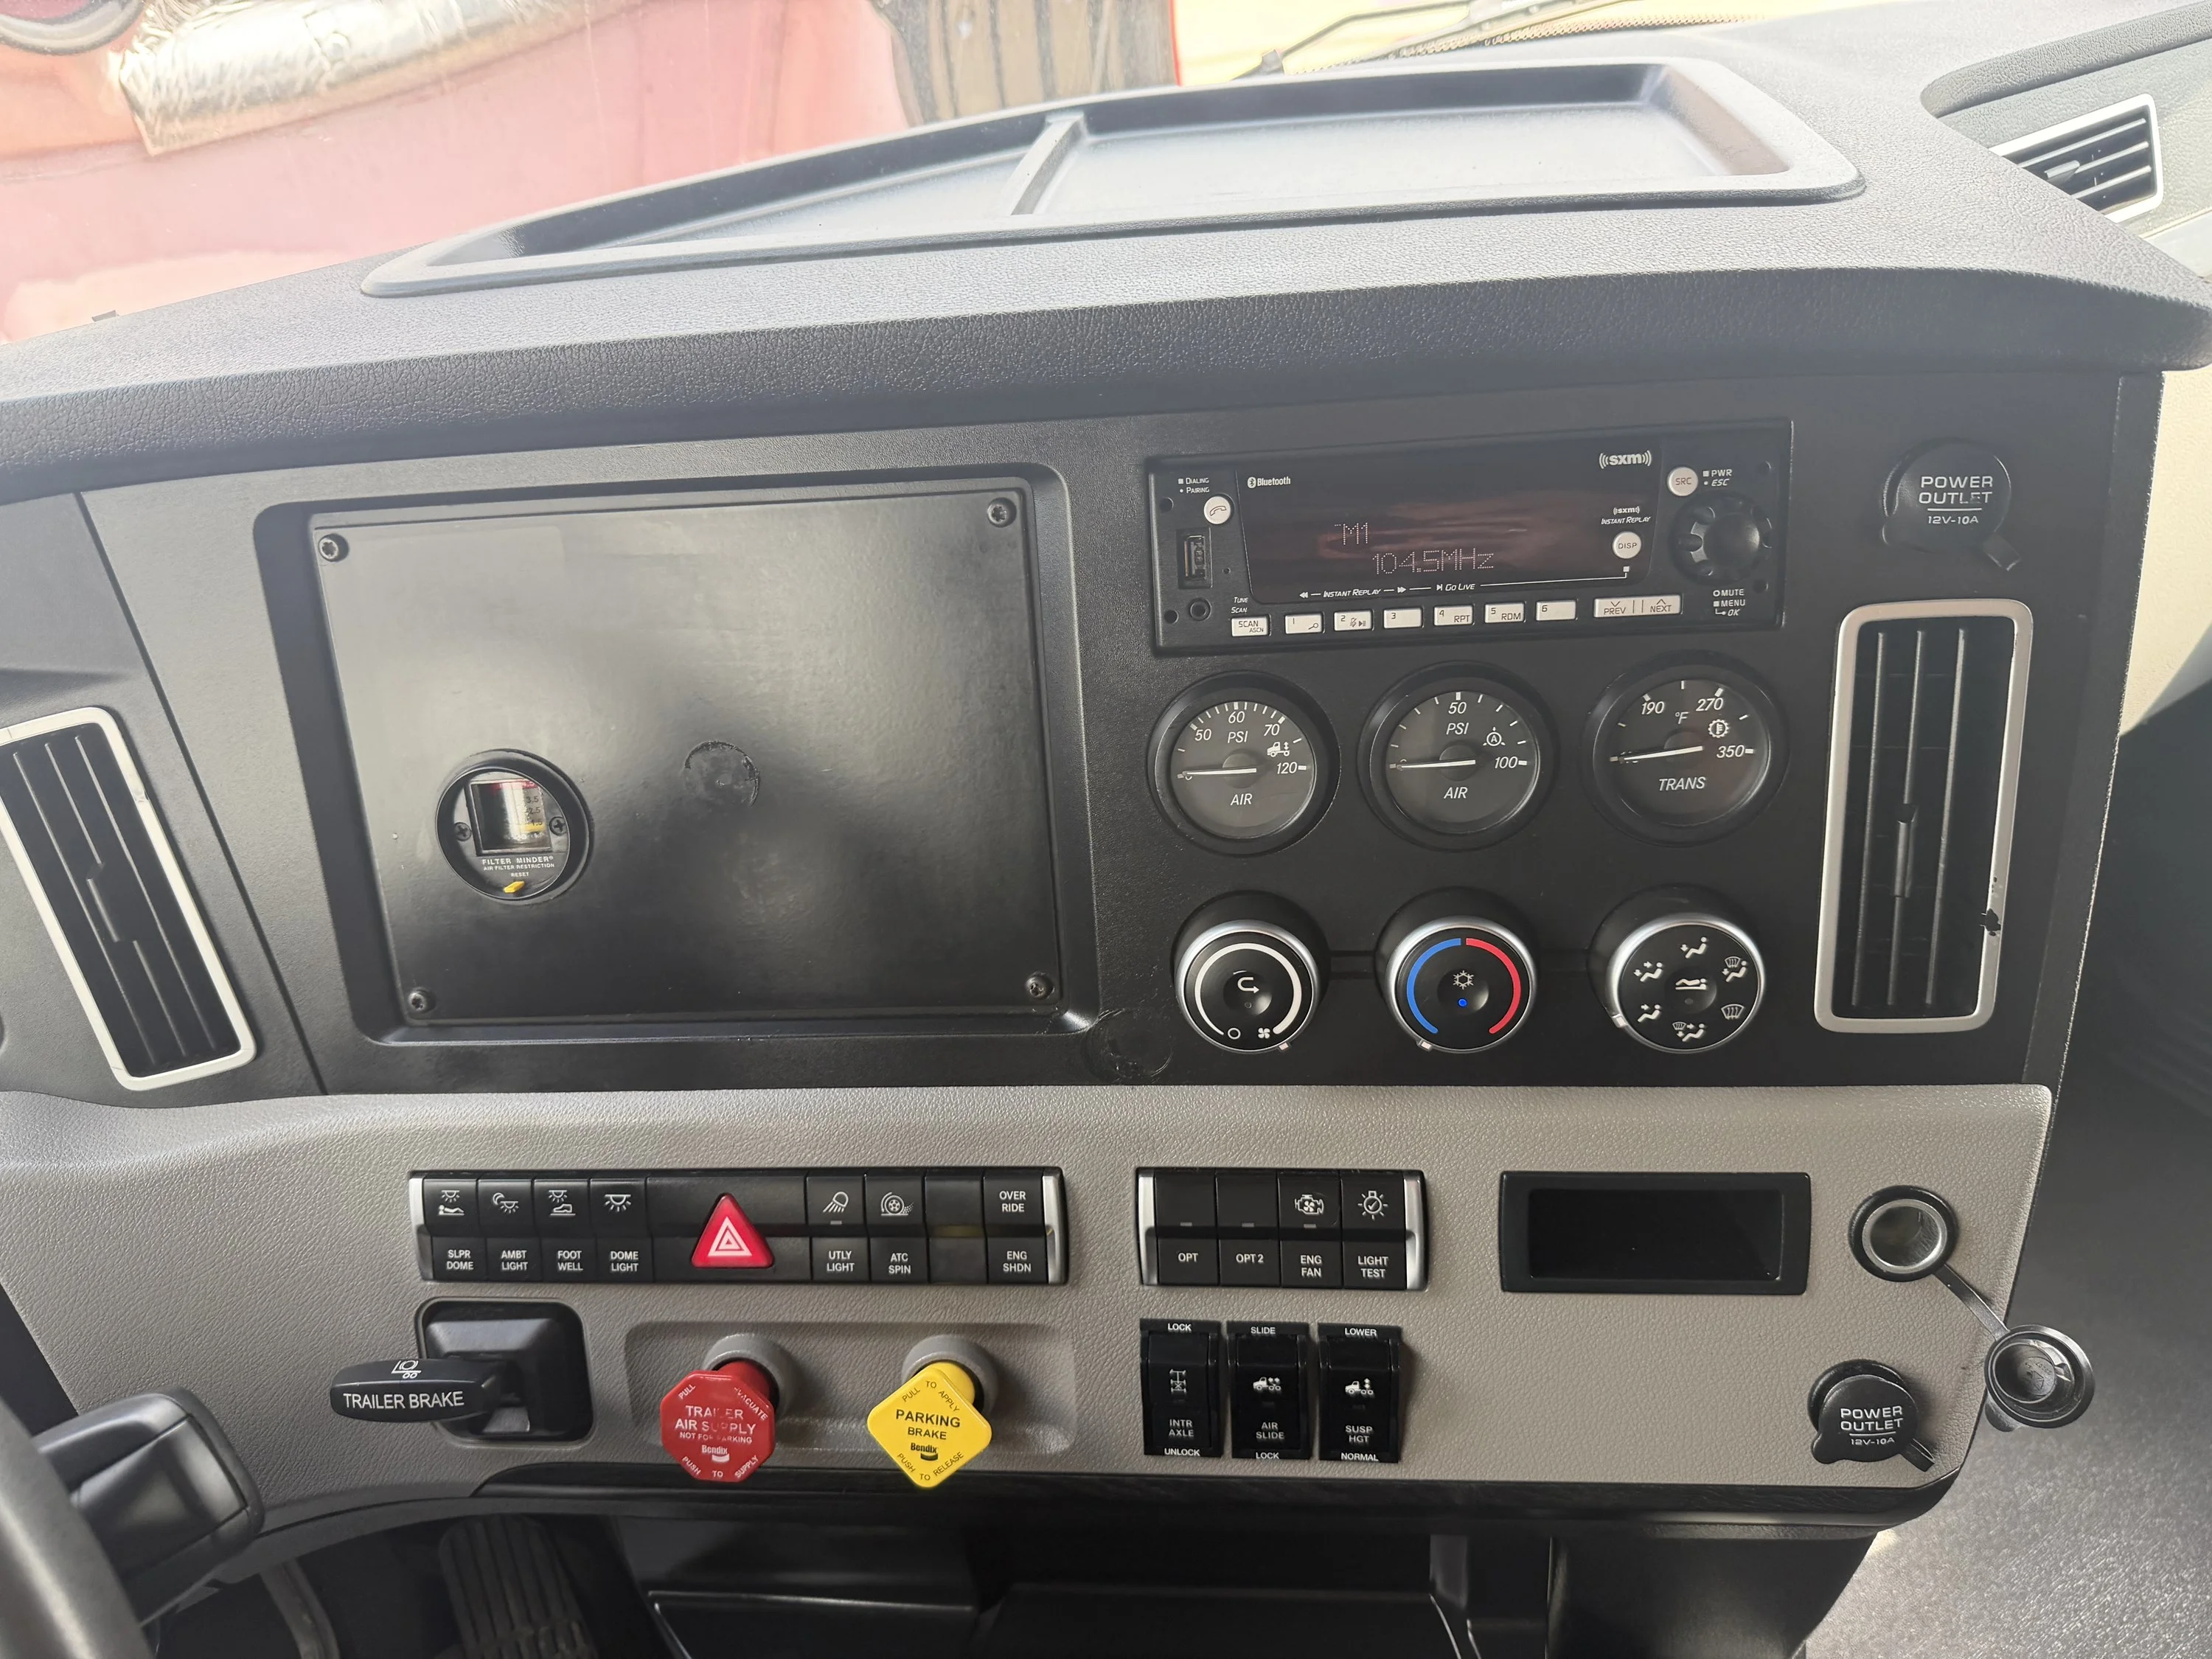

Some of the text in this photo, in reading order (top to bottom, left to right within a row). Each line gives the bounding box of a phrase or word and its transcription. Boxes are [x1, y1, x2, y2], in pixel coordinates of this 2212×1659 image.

[1711, 469, 1733, 477] PWR
[1256, 476, 1291, 487] Bluetooth
[1674, 477, 1692, 486] SRC
[1711, 479, 1730, 487] ESC
[1920, 476, 1993, 488] POWER
[1919, 491, 1993, 504] OUTLET
[1927, 515, 1979, 524] 12V-10A
[1335, 522, 1368, 545] M1
[1372, 548, 1494, 574] 104.5MHz
[1720, 588, 1745, 597] MUTE
[1541, 604, 1548, 612] 6
[1720, 599, 1746, 607] MENU
[1603, 606, 1626, 615] PREV
[1649, 604, 1672, 613] NEXT
[1727, 608, 1741, 616] OK
[1454, 615, 1470, 623] RPT
[1500, 611, 1522, 621] RDM
[1238, 620, 1259, 628] SCAN
[1448, 702, 1467, 714] 50
[1641, 700, 1665, 714] 190
[1695, 698, 1724, 712] 270
[1228, 711, 1245, 724] 60
[1263, 723, 1280, 737] 70
[1446, 723, 1470, 735] PSI
[1194, 728, 1212, 742] 50
[1227, 731, 1248, 744] PSI
[1716, 744, 1745, 758] 350
[1494, 756, 1519, 769] 100
[1276, 761, 1298, 775] 120
[1658, 776, 1706, 791] TRANS
[1443, 787, 1468, 799] AIR
[1230, 793, 1253, 806] AIR
[481, 858, 512, 866] FILTER
[999, 1190, 1026, 1200] OVER
[1001, 1203, 1025, 1212] RIDE
[448, 1249, 470, 1259] SLPR
[501, 1250, 527, 1259] AMBT
[557, 1250, 582, 1259] FOOT
[611, 1251, 639, 1261] DOME
[828, 1251, 852, 1260] UTLY
[890, 1252, 908, 1262] ATC
[1006, 1251, 1028, 1261] ENG
[1178, 1253, 1198, 1262] OPT
[1235, 1253, 1264, 1263] OPT 2
[1300, 1255, 1322, 1265] ENG
[1357, 1255, 1388, 1266] LIGHT
[446, 1261, 474, 1270] DOME
[501, 1261, 528, 1271] LIGHT
[557, 1261, 583, 1271] WELL
[611, 1262, 639, 1272] LIGHT
[826, 1262, 855, 1272] LIGHT
[888, 1264, 911, 1274] SPIN
[1003, 1262, 1032, 1273] SHDN
[1301, 1267, 1322, 1277] FAN
[1360, 1267, 1385, 1278] TEST
[1167, 1323, 1192, 1332] LOCK
[1251, 1326, 1276, 1335] SLIDE
[1344, 1328, 1377, 1337] LOWER
[678, 1383, 696, 1399] PULL
[902, 1380, 960, 1412] PULL TO APPLY
[343, 1391, 465, 1409] TRAILER BRAKE
[1840, 1405, 1903, 1419] POWER
[896, 1408, 961, 1428] PARKING
[1169, 1419, 1193, 1427] INTR
[675, 1418, 698, 1430] AIR
[1261, 1422, 1279, 1430] AIR
[1345, 1425, 1373, 1433] SUSP
[1840, 1417, 1904, 1431] OUTLET
[679, 1431, 696, 1439] NOT
[908, 1427, 947, 1440] BRAKE
[1168, 1429, 1194, 1437] AXLE
[1256, 1431, 1284, 1439] SLIDE
[1349, 1435, 1370, 1443] HGT
[1851, 1436, 1896, 1445] 12V-10A
[701, 1444, 728, 1455] Bendix
[911, 1442, 937, 1453] Bendix
[1164, 1448, 1200, 1457] UNLOCK
[1256, 1451, 1280, 1460] LOCK
[1340, 1453, 1379, 1462] NORMAL
[682, 1455, 759, 1478] PUSH TO SUPPLY
[897, 1451, 964, 1481] PUSH TO RELEASE
